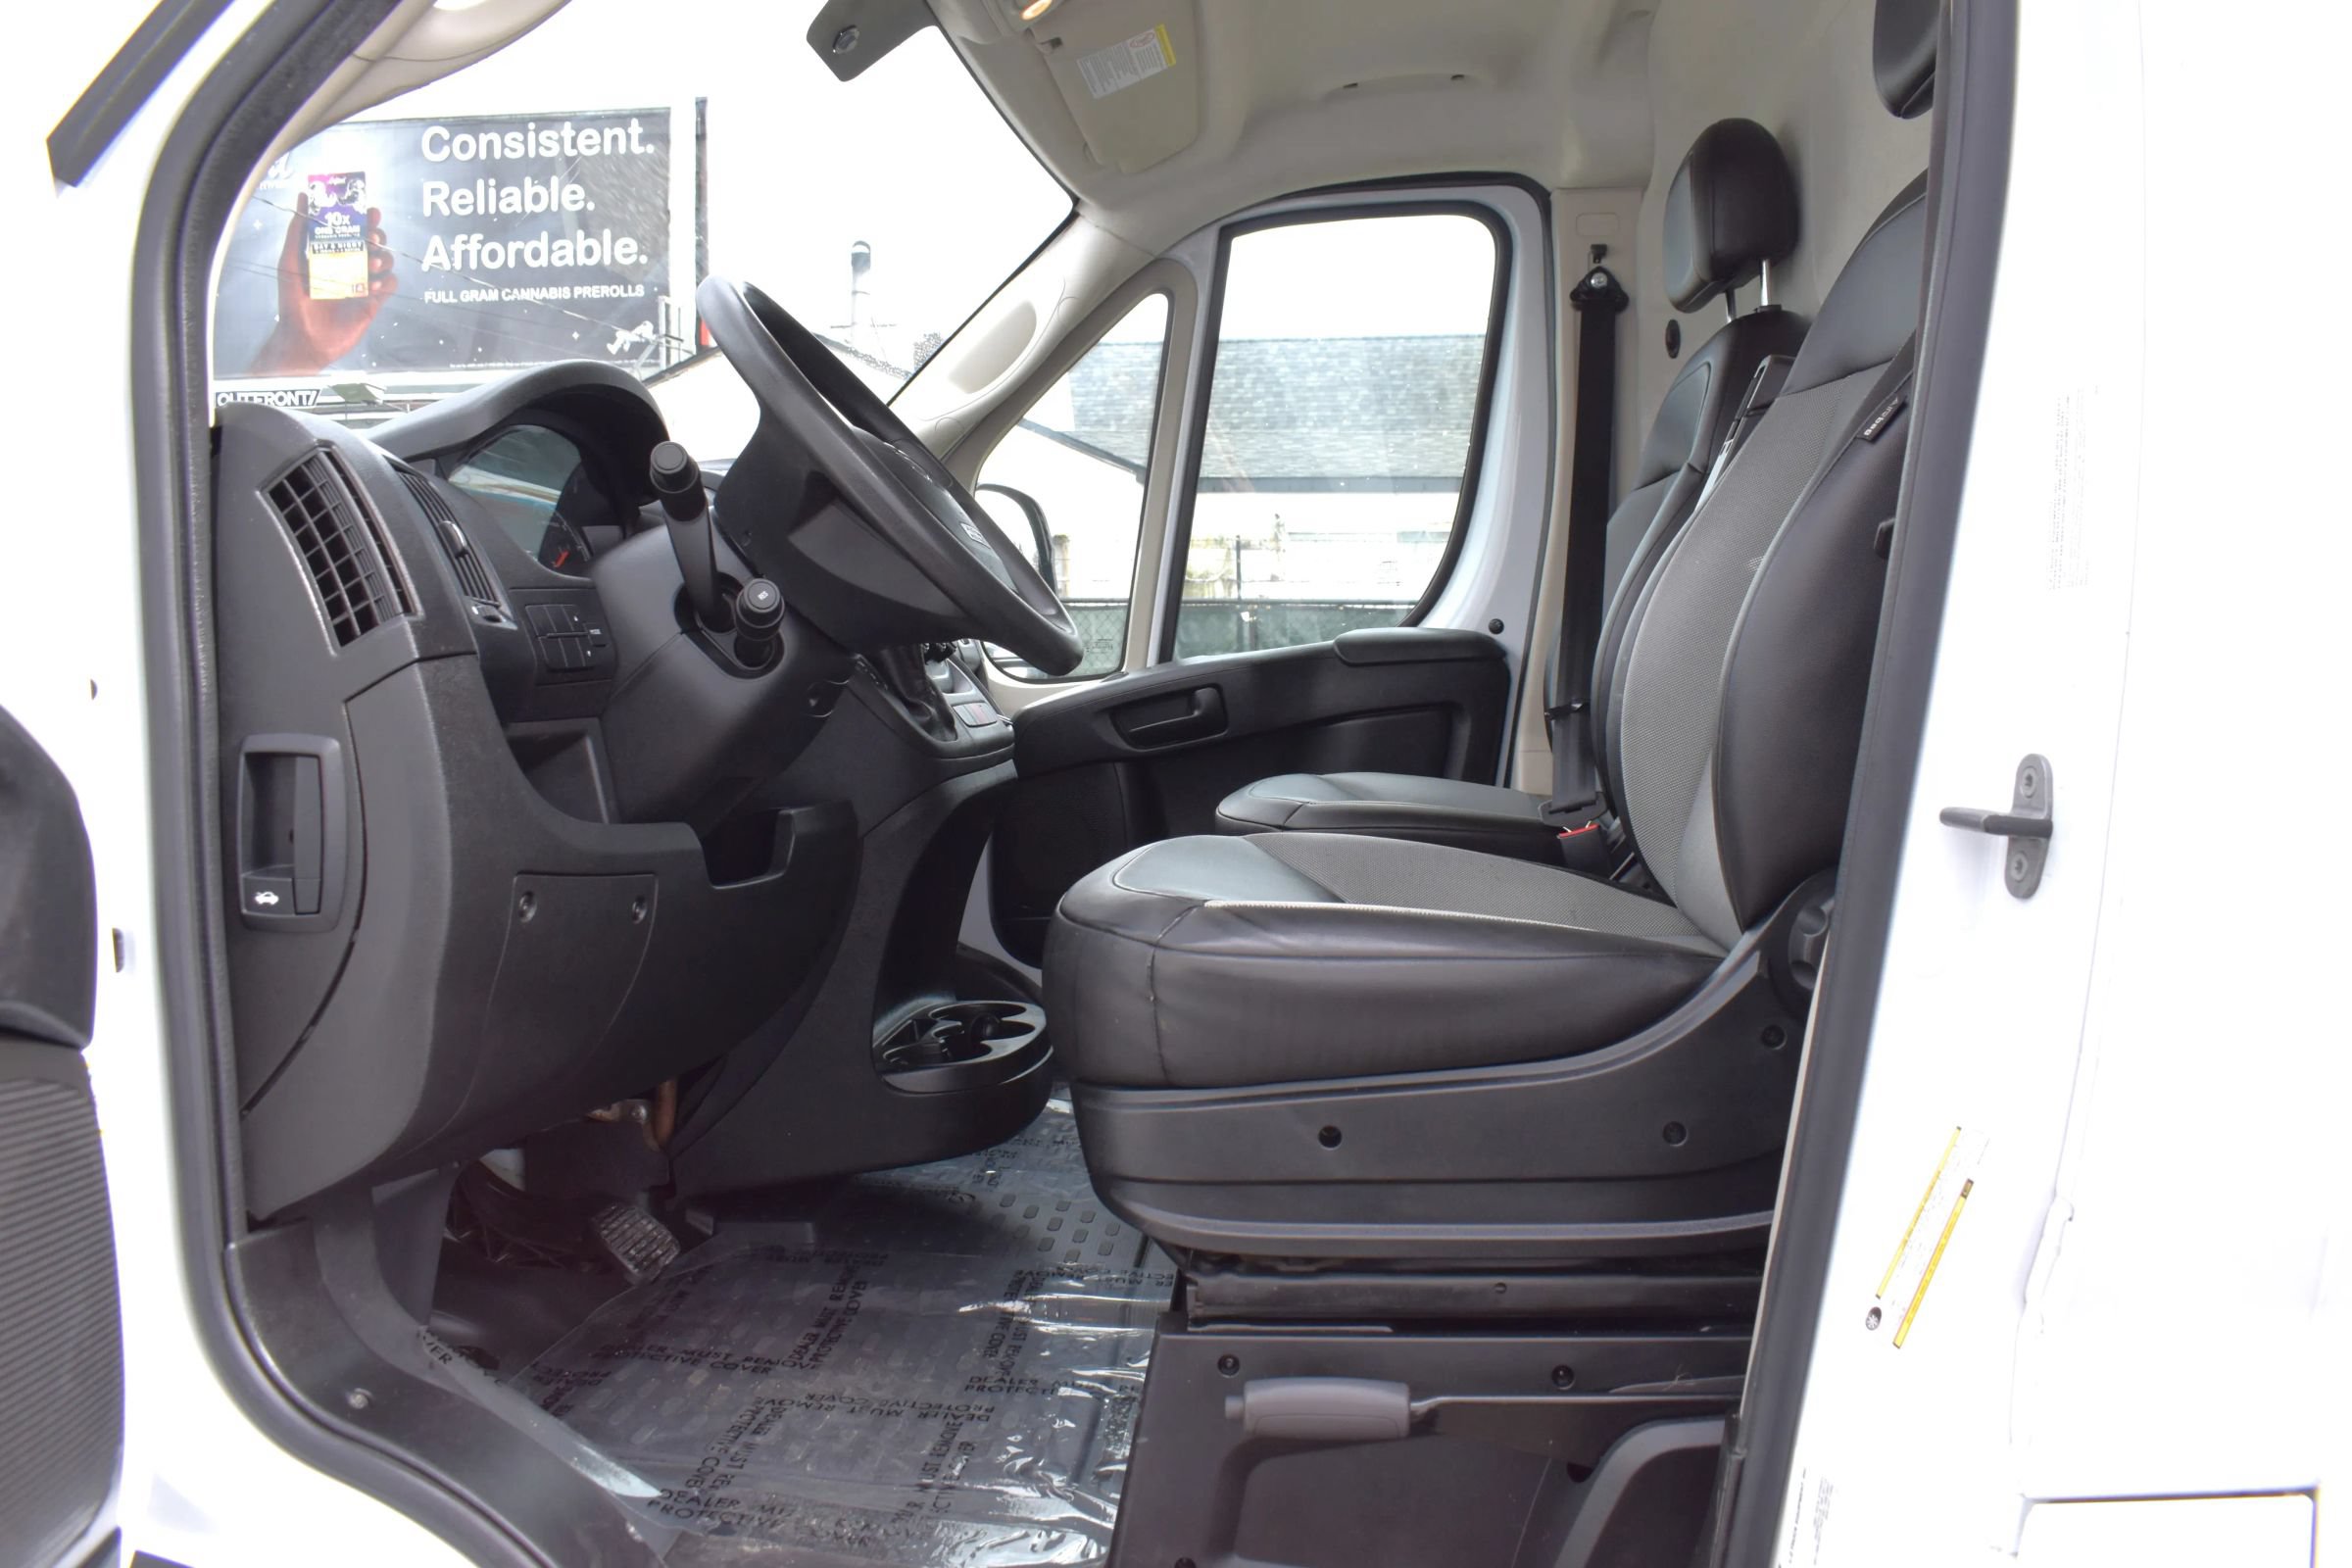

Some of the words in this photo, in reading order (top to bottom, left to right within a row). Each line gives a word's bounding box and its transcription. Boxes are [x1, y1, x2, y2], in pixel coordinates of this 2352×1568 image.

[421, 118, 655, 163] Consistent.
[422, 175, 596, 218] Reliable.
[421, 228, 649, 272] Affordable.
[424, 289, 458, 304] FULL
[460, 288, 499, 303] GRAM
[502, 285, 571, 302] CANNABIS
[574, 284, 645, 299] PREROLLS
[710, 1360, 772, 1374] COVER
[684, 1455, 721, 1489] COVER
